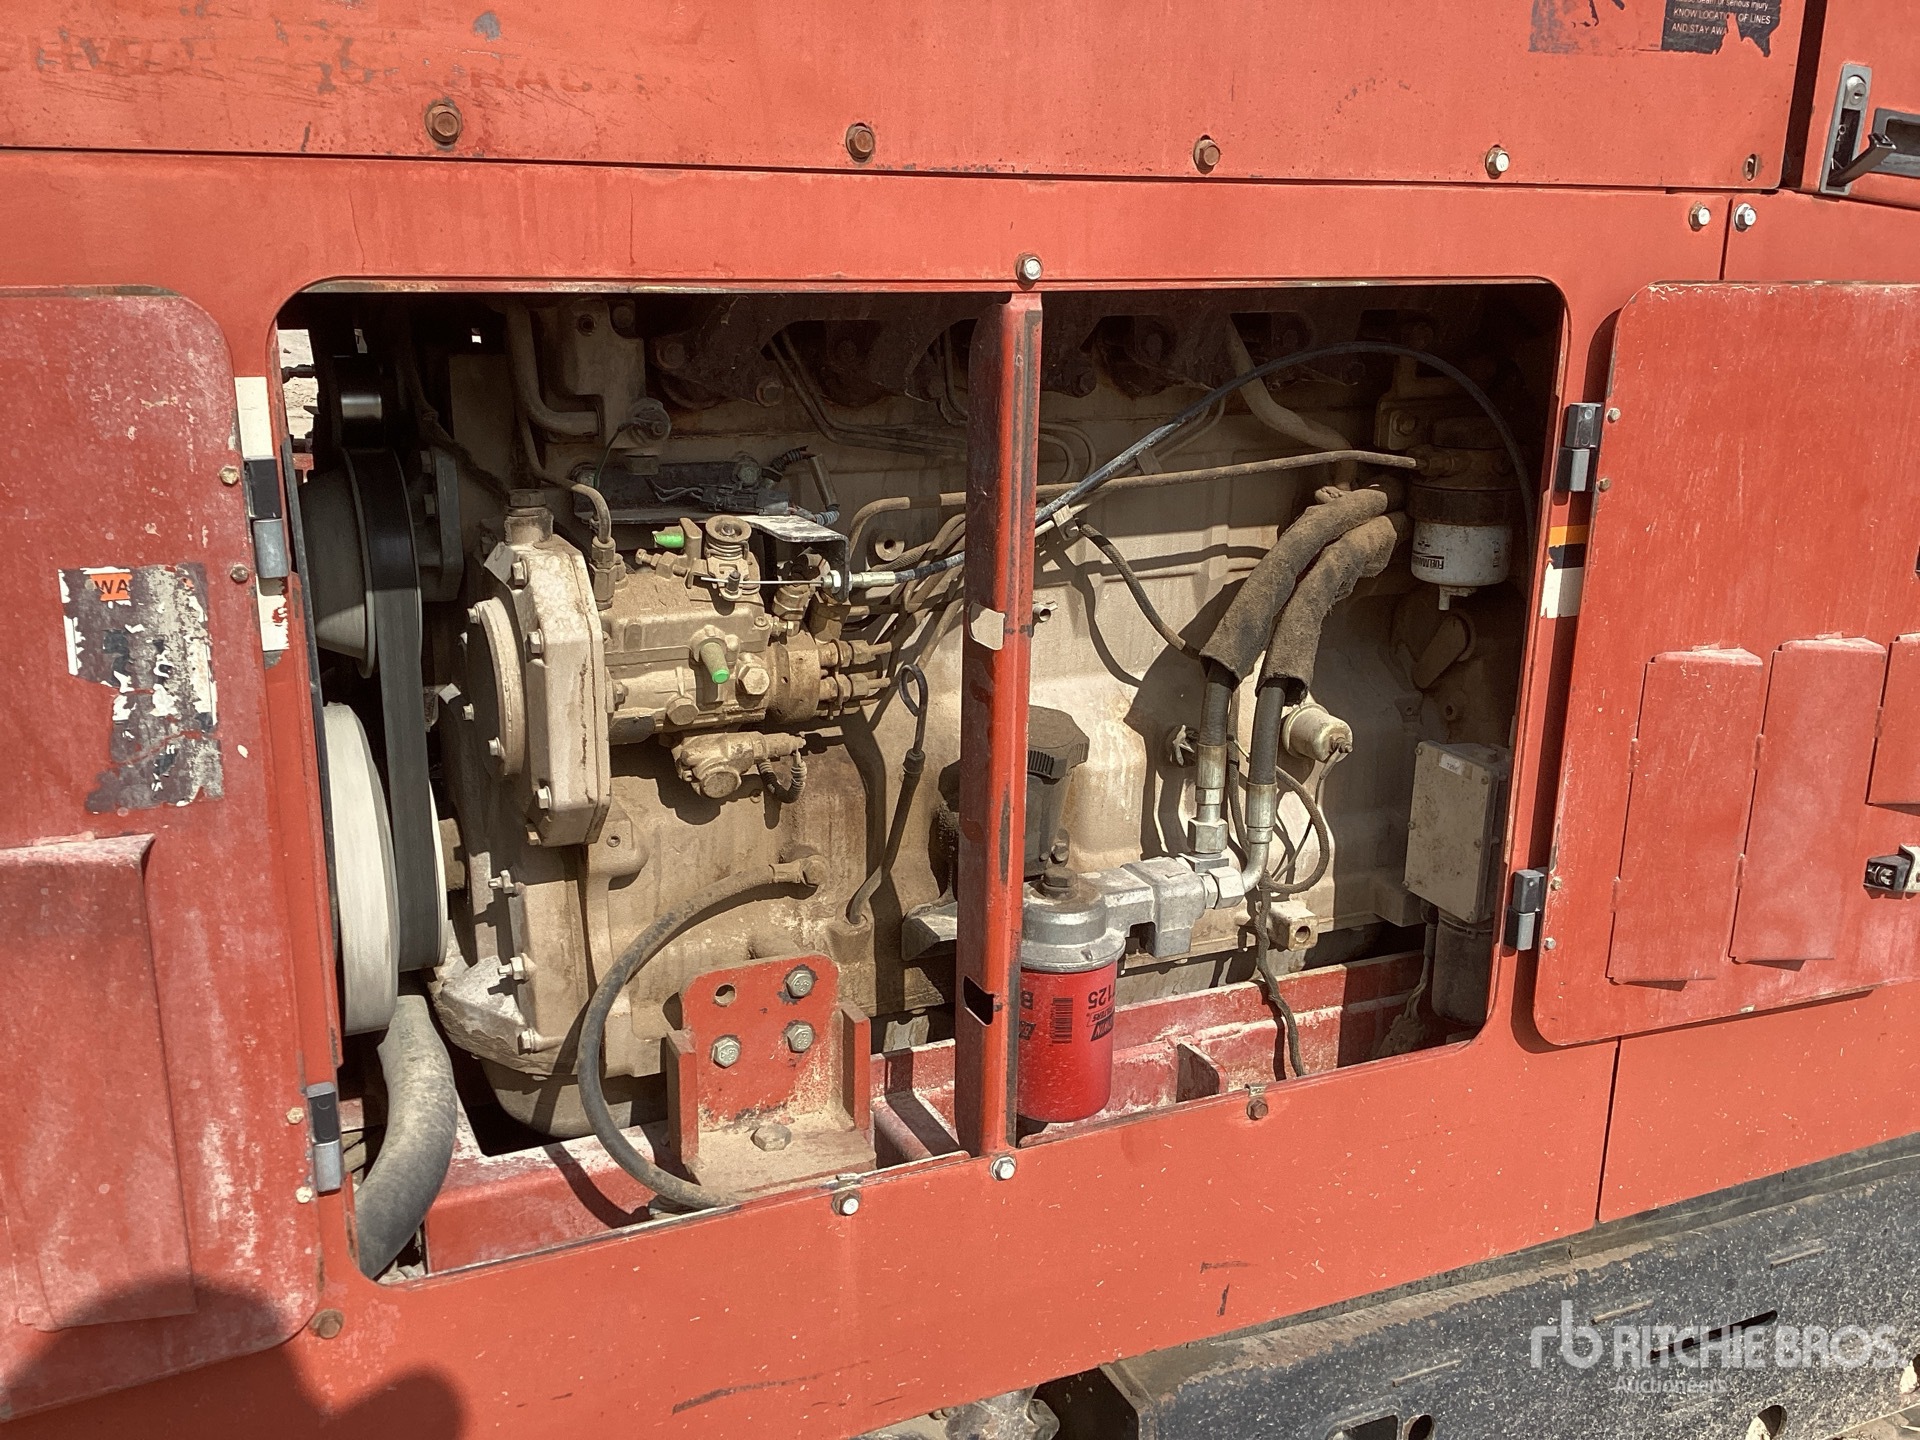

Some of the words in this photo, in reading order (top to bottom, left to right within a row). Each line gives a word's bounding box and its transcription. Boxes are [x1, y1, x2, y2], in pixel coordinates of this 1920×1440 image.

[1751, 1, 1769, 12] injury
[1673, 7, 1697, 18] KNOW
[1738, 12, 1749, 23] OF
[1750, 13, 1771, 25] LINES
[1671, 22, 1688, 32] AND
[1690, 23, 1709, 34] STAY
